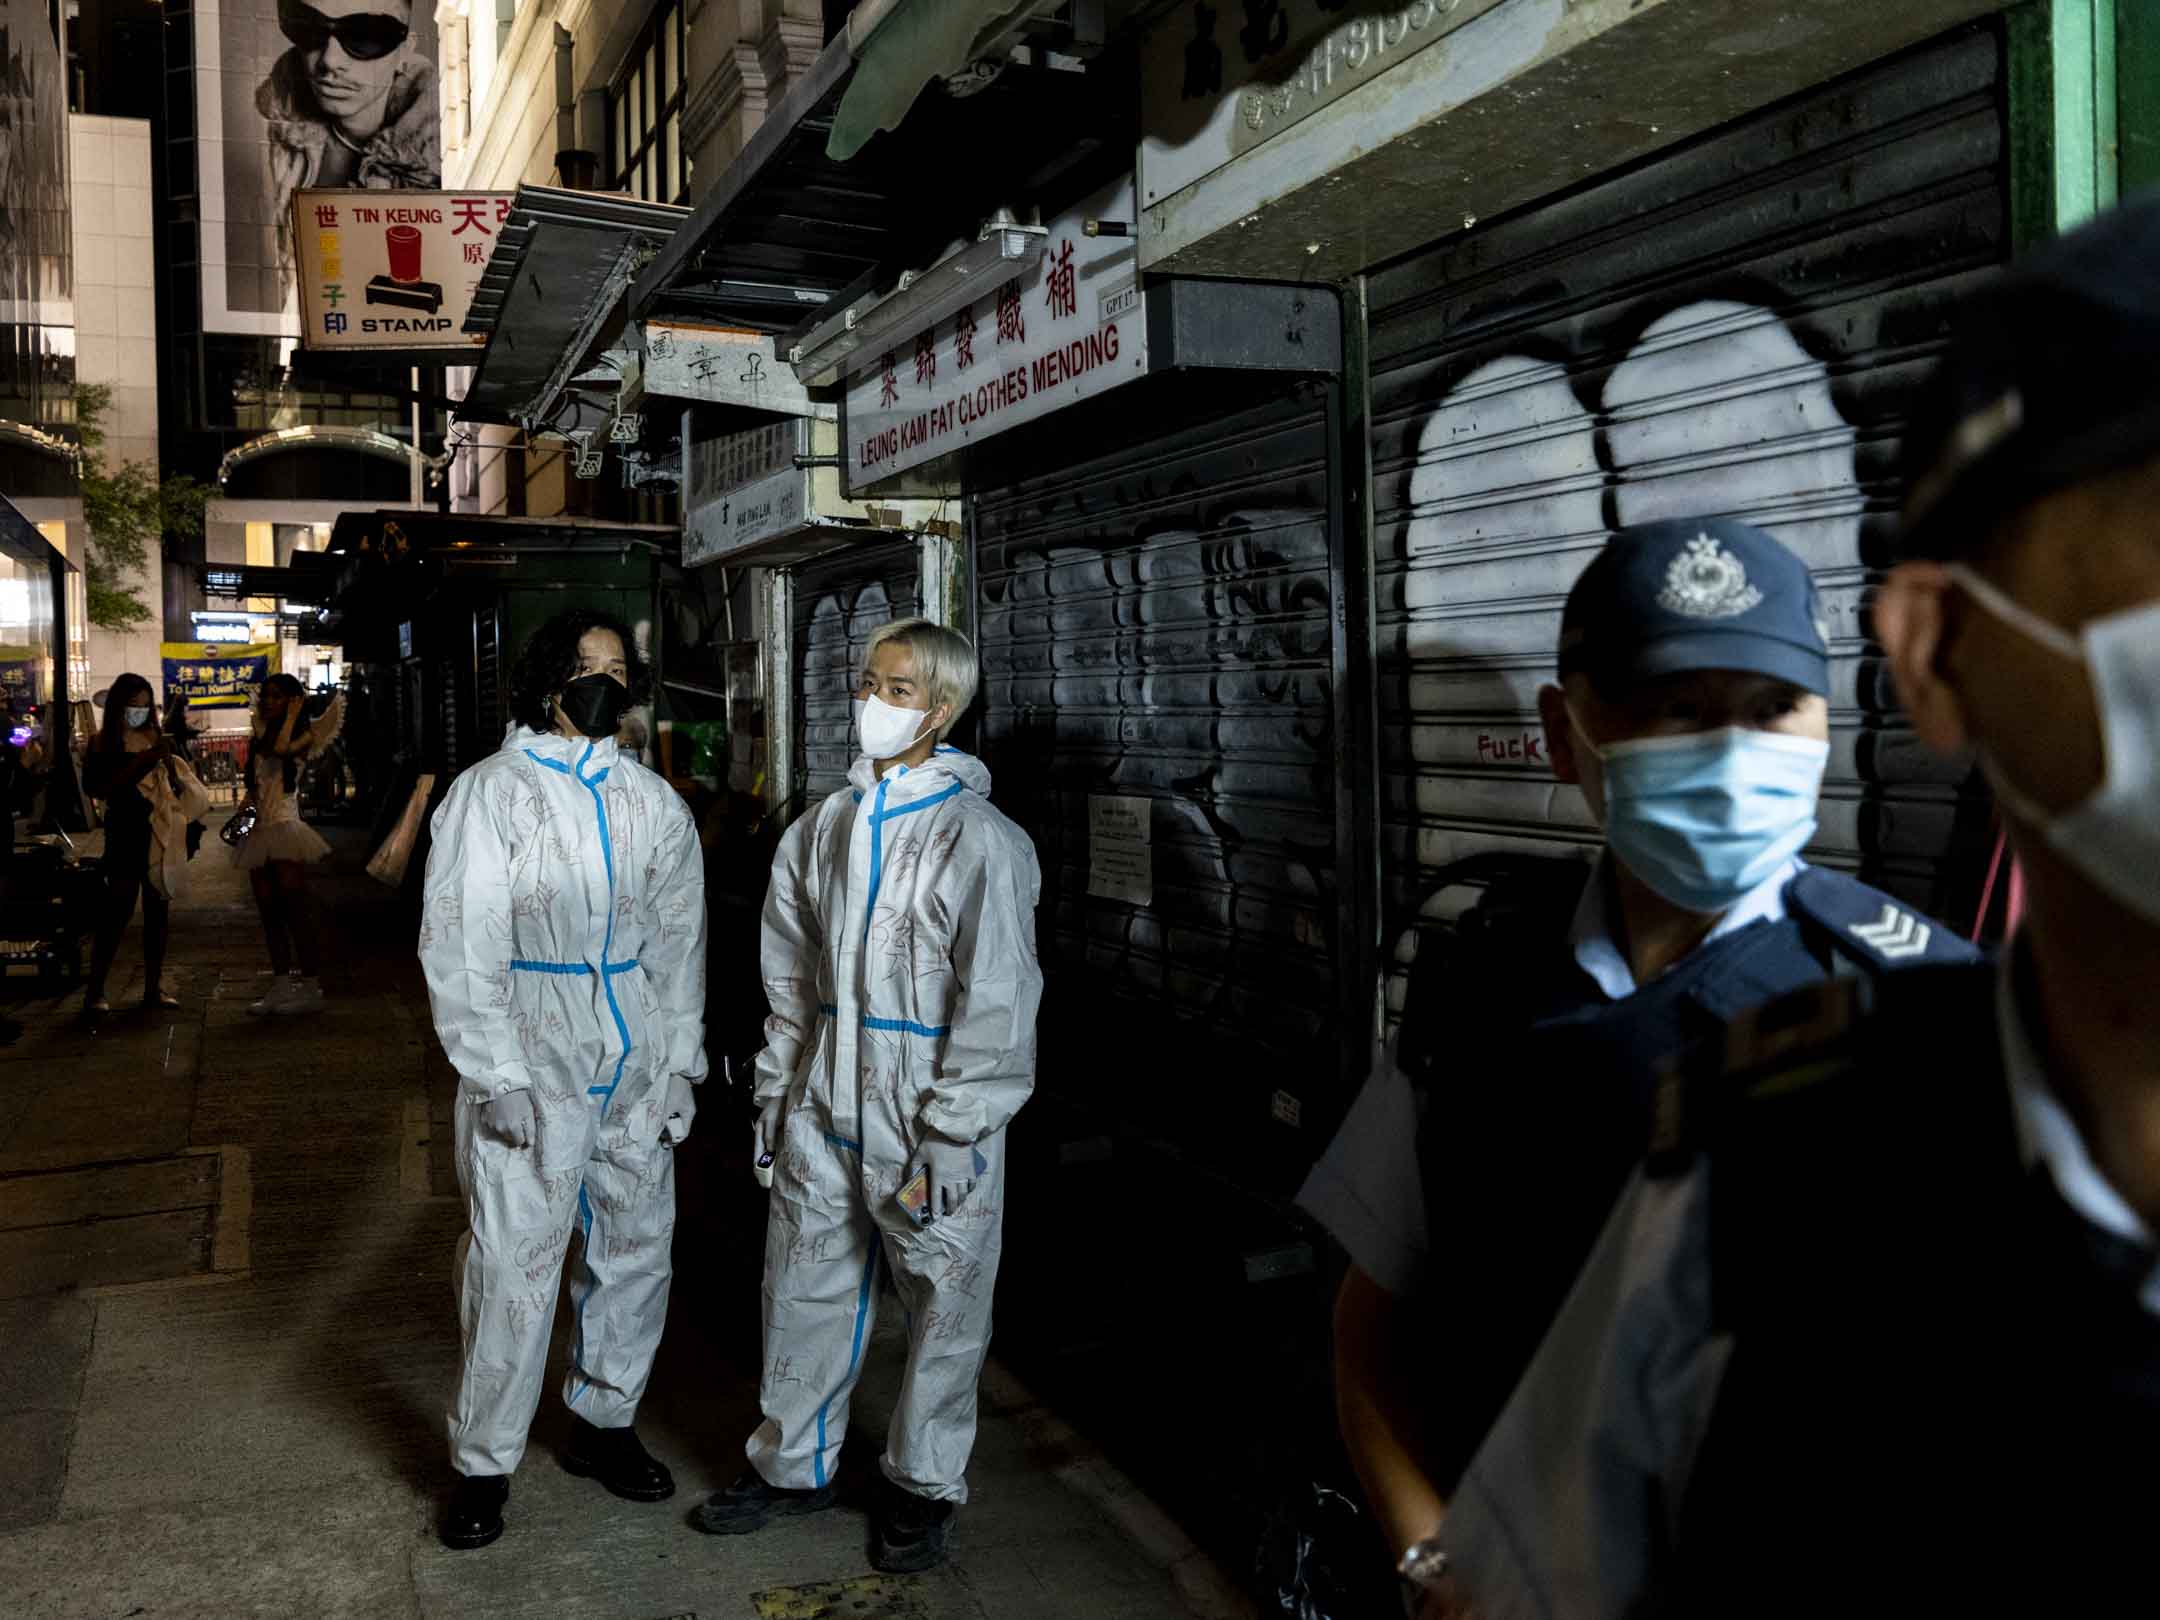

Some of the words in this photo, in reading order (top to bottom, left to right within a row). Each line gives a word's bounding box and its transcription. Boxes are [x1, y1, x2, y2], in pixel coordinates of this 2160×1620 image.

[351, 208, 380, 224] TIN
[386, 208, 443, 224] KEUNG
[1105, 298, 1123, 317] GPT
[1124, 288, 1135, 309] 17
[361, 318, 453, 333] STAMP
[859, 428, 899, 469] LEUNG
[900, 414, 928, 450] KAM
[930, 399, 957, 439] FAT
[958, 366, 1028, 426] CLOTHES
[1031, 324, 1120, 394] MENDING
[168, 683, 183, 695] To
[185, 683, 206, 695] Lan
